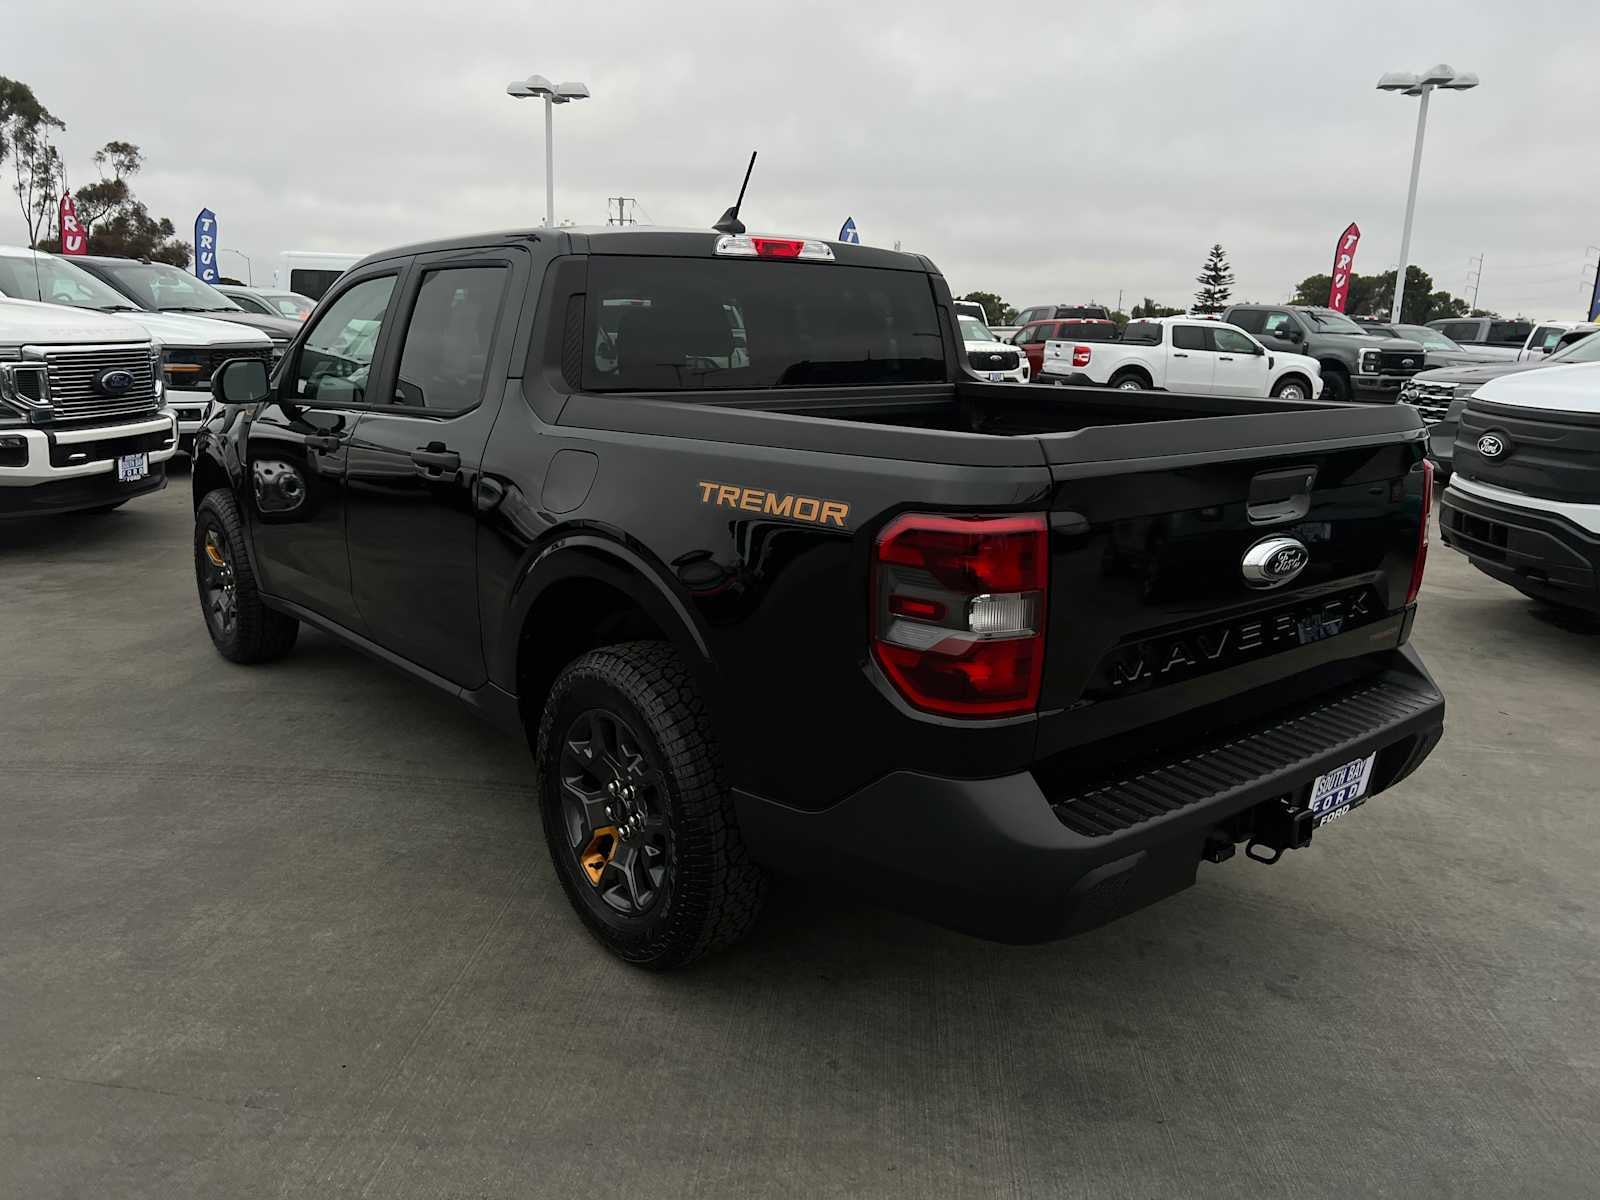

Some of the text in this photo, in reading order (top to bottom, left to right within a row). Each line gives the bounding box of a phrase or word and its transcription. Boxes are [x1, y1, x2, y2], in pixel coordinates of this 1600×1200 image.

[698, 480, 850, 527] TREMOR
[1274, 548, 1303, 574] Ford
[1316, 759, 1367, 797] SOUTH BAY
[1312, 783, 1358, 813] FORD
[1319, 803, 1351, 828] FORD
